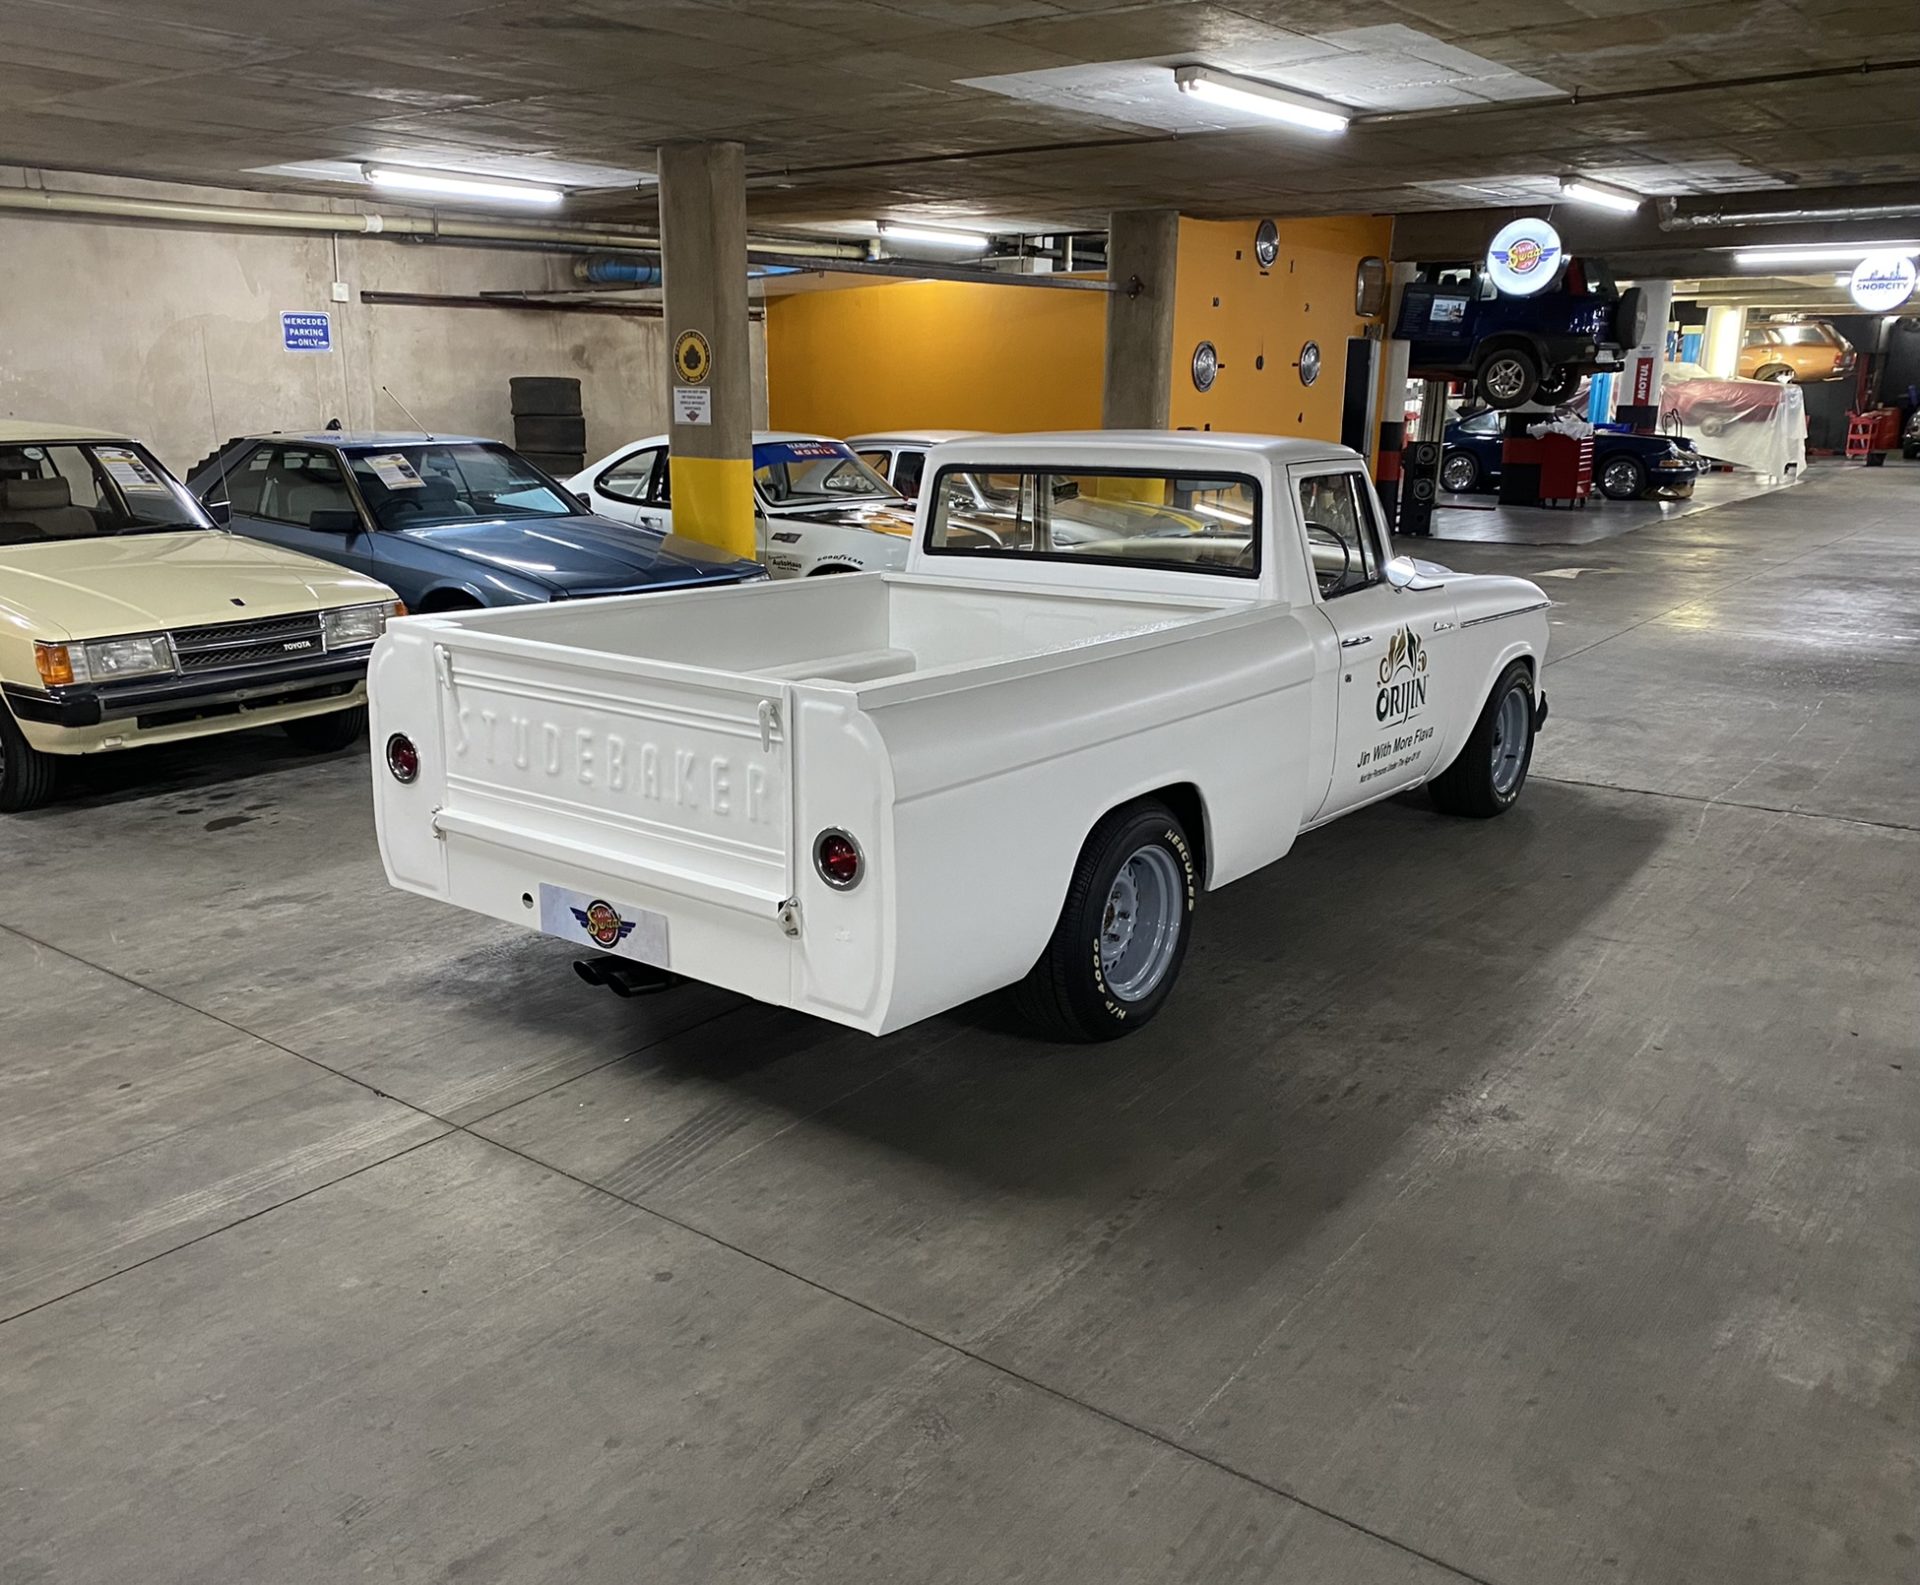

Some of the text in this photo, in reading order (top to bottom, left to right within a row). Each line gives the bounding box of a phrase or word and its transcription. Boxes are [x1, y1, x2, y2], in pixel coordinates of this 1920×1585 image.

[1856, 282, 1909, 291] SNORCITY
[284, 318, 327, 326] MERCEDES
[289, 328, 324, 337] PARKING
[297, 339, 319, 347] ONLY
[1637, 364, 1649, 400] MOTUL
[793, 448, 837, 456] MOBILE
[283, 641, 311, 651] TOYOTA
[1376, 675, 1427, 724] ORIJIN
[1357, 726, 1434, 768] Jin With More Flava
[453, 706, 773, 825] STUDEBAKER
[1164, 828, 1195, 912] HERCULES
[1093, 937, 1127, 1020] H/P 4000
